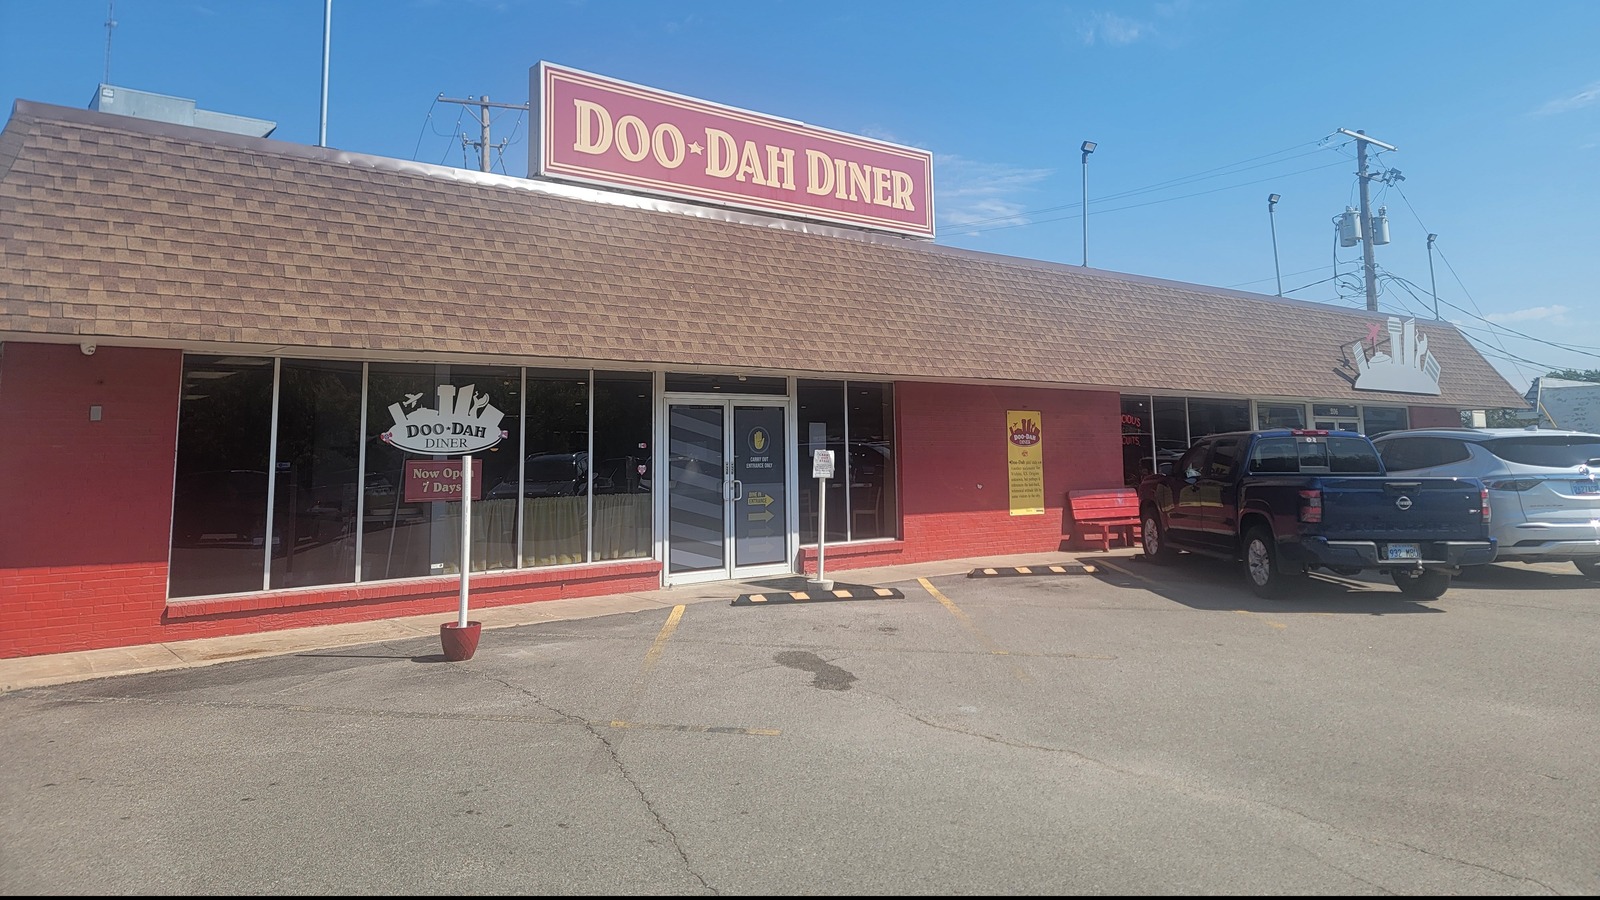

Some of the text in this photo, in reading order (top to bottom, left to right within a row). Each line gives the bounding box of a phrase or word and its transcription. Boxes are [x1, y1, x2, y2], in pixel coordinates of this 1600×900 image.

[805, 148, 915, 212] DINER
[425, 438, 468, 449] DINER
[413, 467, 475, 480] Now Op
[422, 482, 461, 494] 7 Days
[1389, 548, 1402, 558] 932
